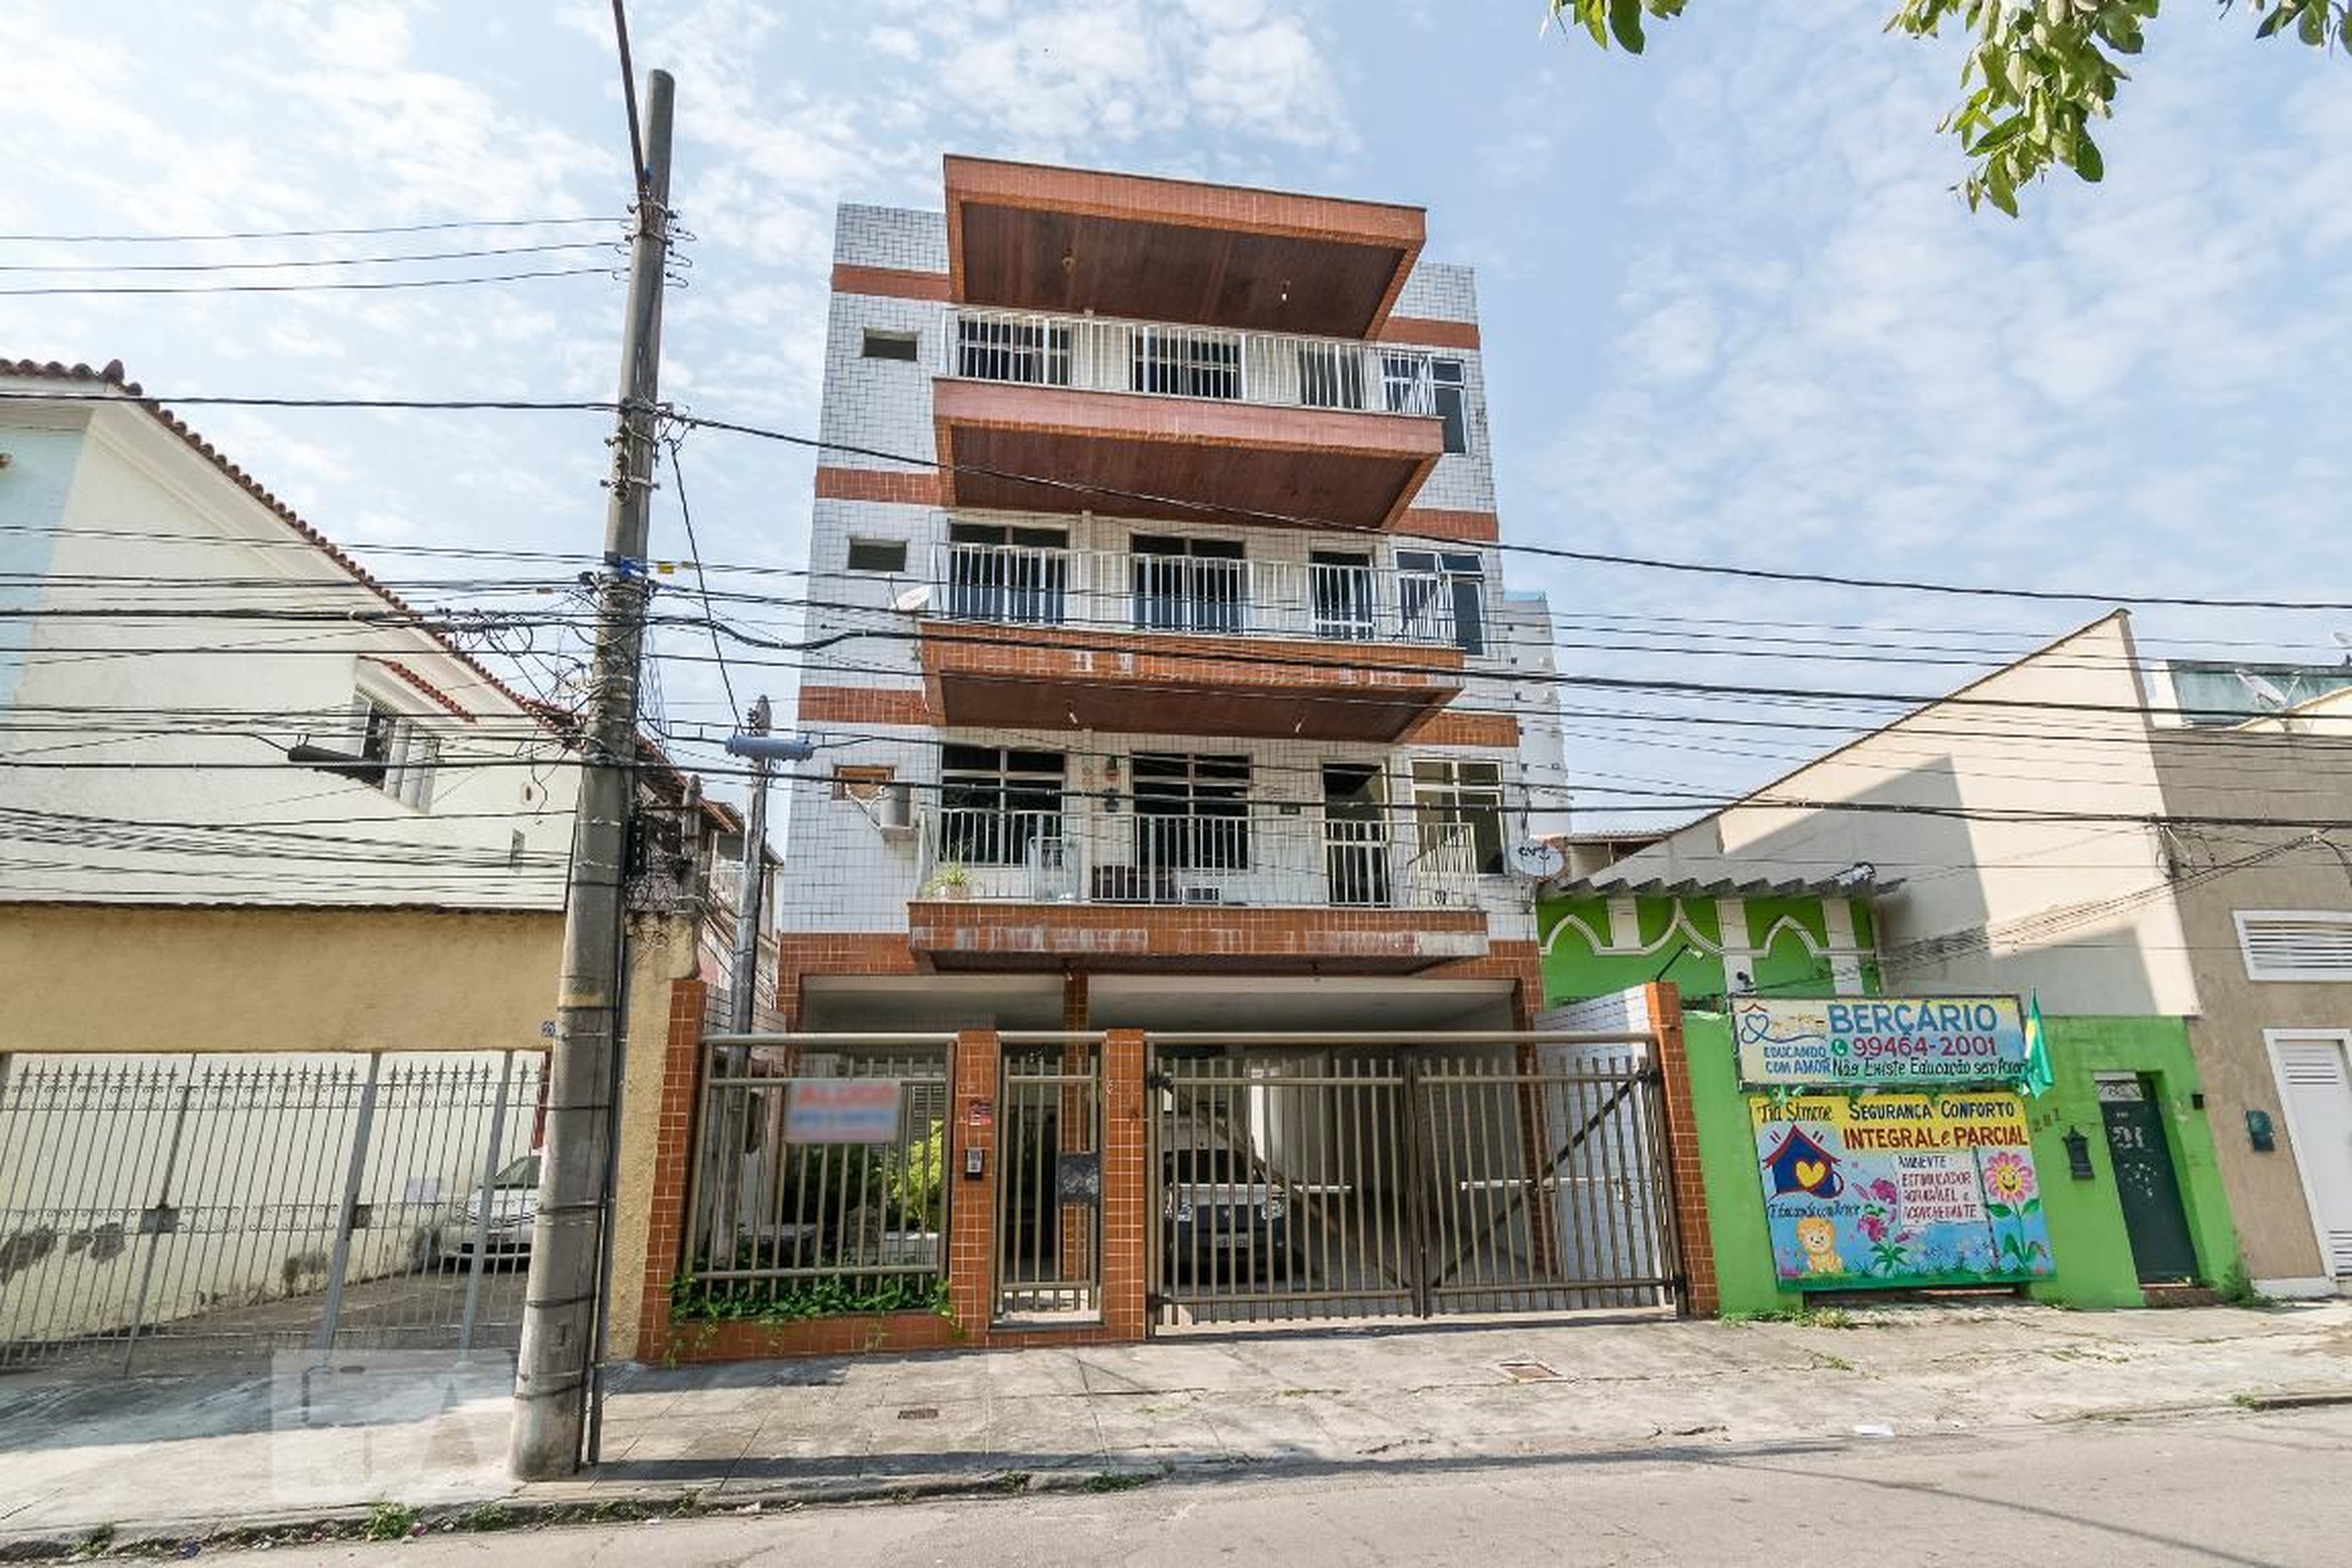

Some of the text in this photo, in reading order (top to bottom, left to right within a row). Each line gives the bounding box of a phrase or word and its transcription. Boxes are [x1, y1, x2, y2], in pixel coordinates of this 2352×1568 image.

[1764, 1046, 1826, 1058] EDUCANDO
[1853, 1036, 1997, 1057] 99464-2001
[1765, 1059, 1831, 1074] COM AMOR
[1864, 1058, 1906, 1077] Existe
[1910, 1058, 1971, 1076] Educação
[1940, 1100, 2015, 1117] CONFORTO
[1843, 1127, 1940, 1149] INTEGRAL
[1953, 1125, 2027, 1147] PARCIAL
